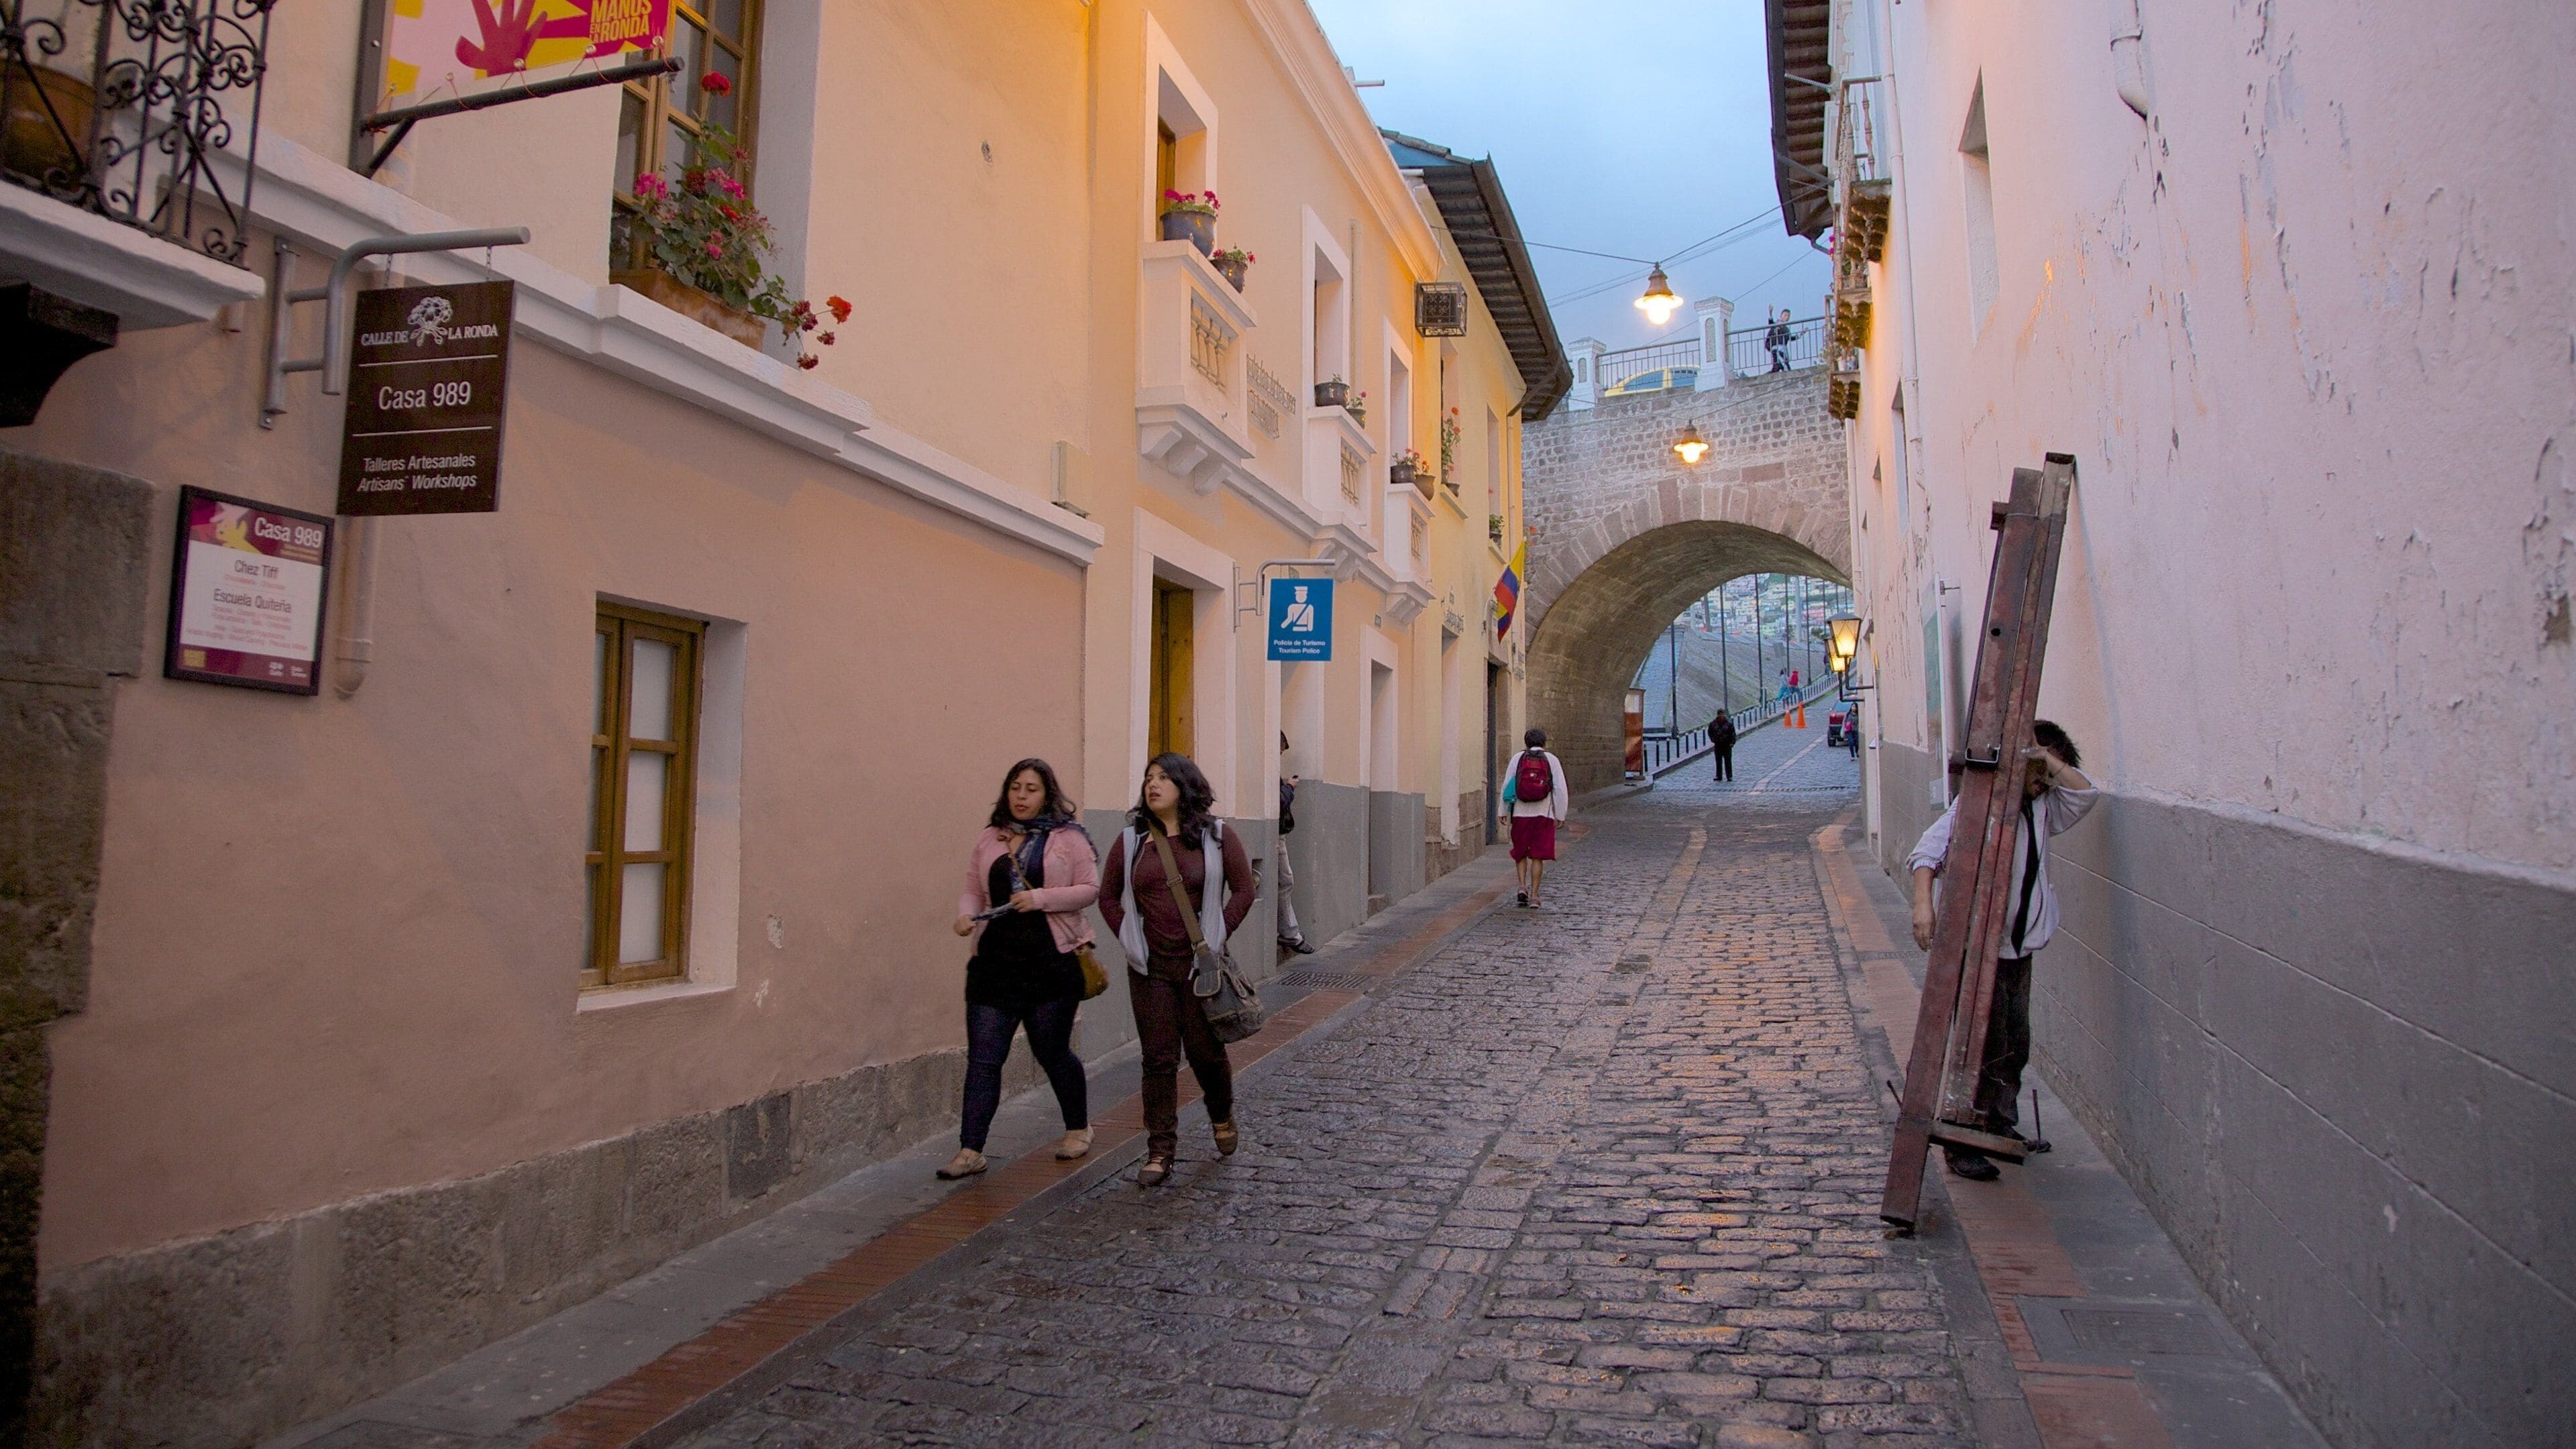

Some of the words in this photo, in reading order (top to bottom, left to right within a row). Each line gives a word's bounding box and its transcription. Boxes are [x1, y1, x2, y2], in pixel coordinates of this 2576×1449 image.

[591, 0, 652, 22] MANOS
[600, 14, 650, 43] RONDA
[361, 331, 393, 345] CALLE
[393, 331, 409, 343] DE
[448, 327, 463, 339] LA
[464, 324, 499, 339] RONDA
[379, 385, 427, 410] Casa
[433, 380, 471, 407] 989
[363, 458, 406, 472] Talleres
[407, 453, 476, 470] Artesanales
[411, 473, 478, 490] Workshops
[255, 517, 290, 542] Casa
[295, 526, 323, 548] 989
[235, 559, 259, 576] Chez
[213, 588, 252, 607] Escuela
